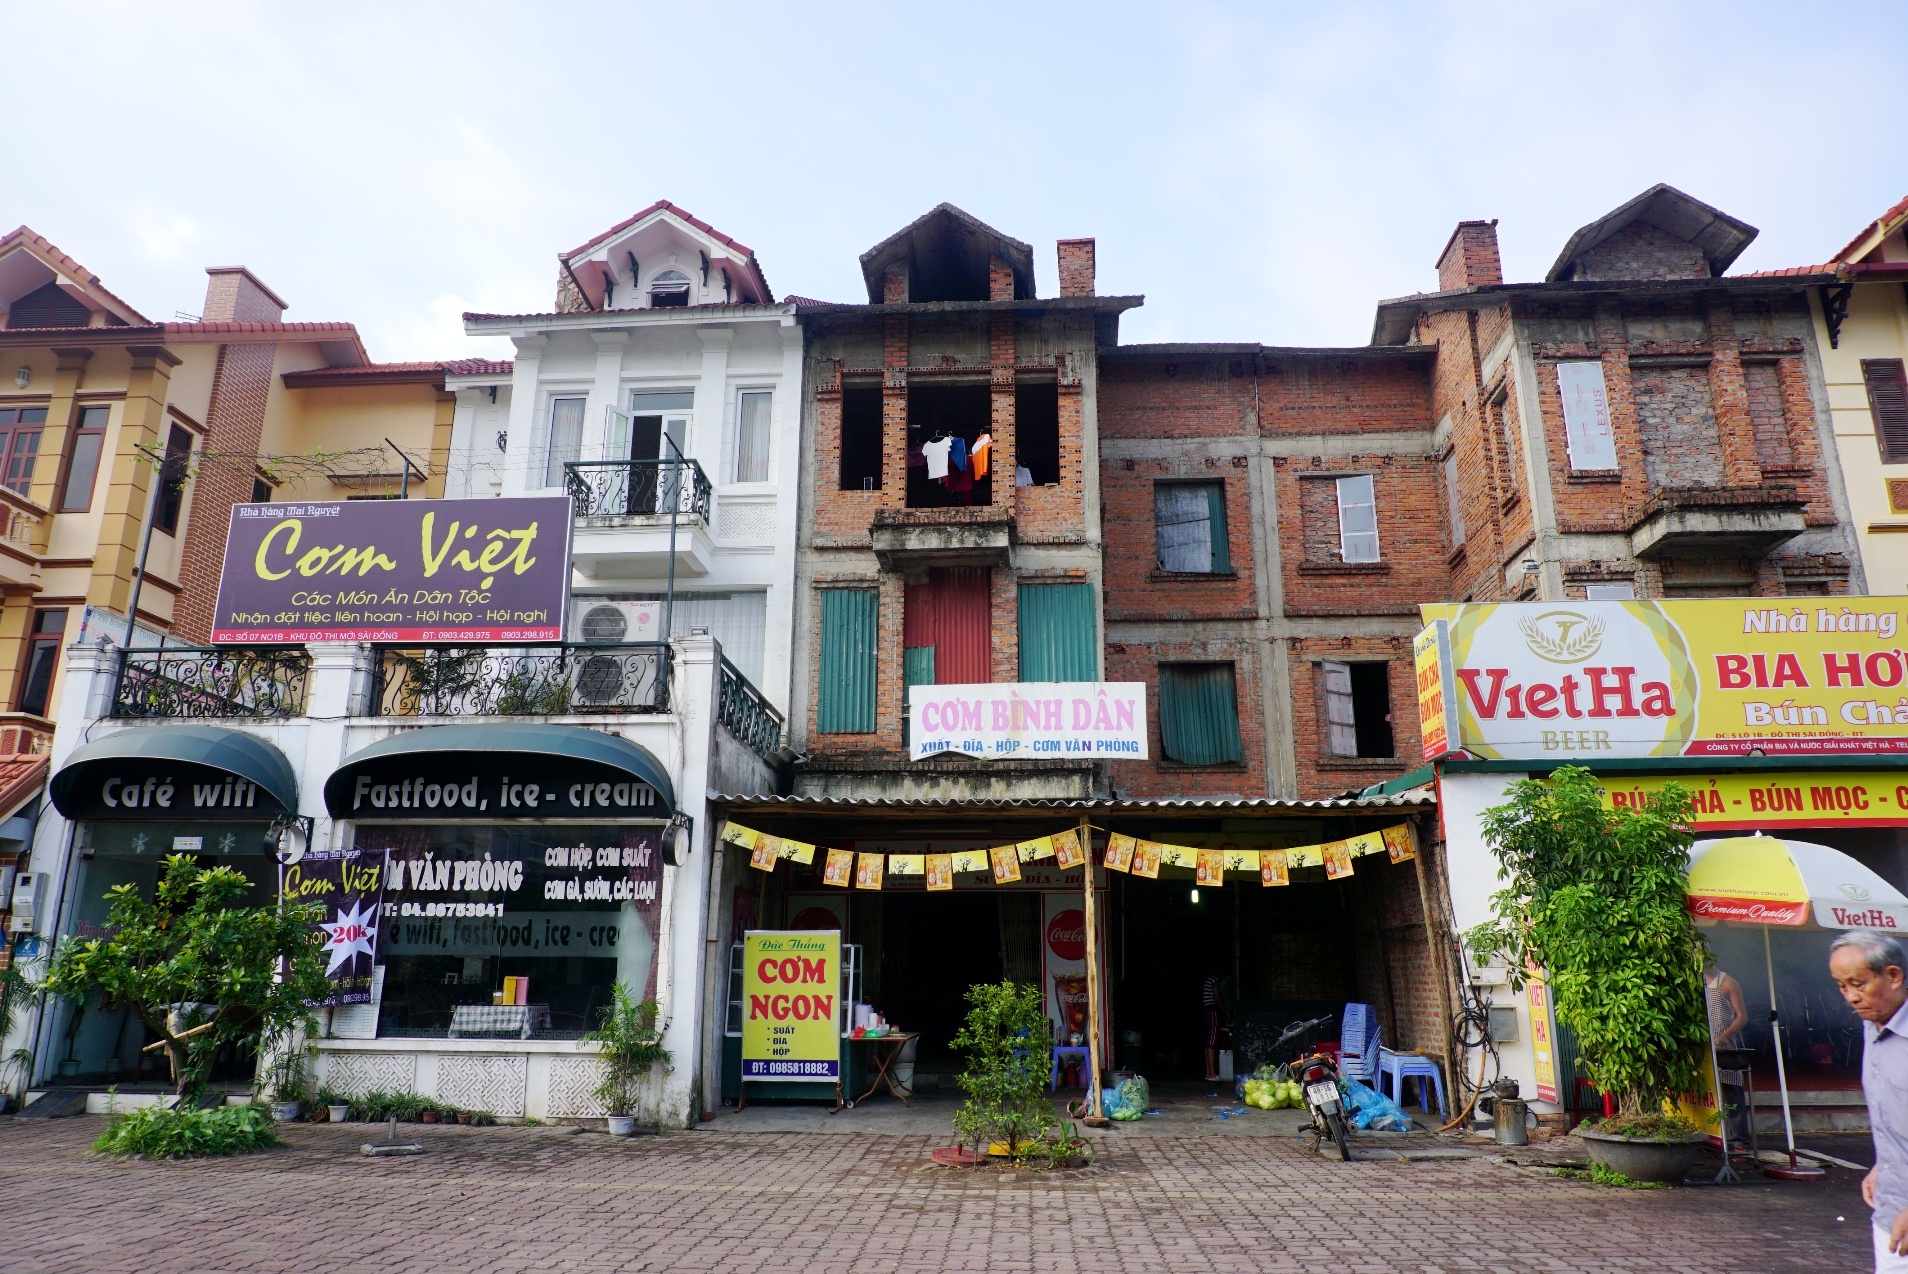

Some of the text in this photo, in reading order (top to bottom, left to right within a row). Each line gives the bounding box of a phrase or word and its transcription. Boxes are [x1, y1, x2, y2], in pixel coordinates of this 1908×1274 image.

[1593, 389, 1607, 436] LEXUS
[287, 506, 306, 516] Mai
[255, 511, 538, 590] Cơm Việt
[291, 588, 491, 606] Các Món Ăn Dân Tộc
[230, 611, 270, 625] Nhận
[274, 611, 300, 625] đặt
[303, 611, 331, 624] tiệc
[335, 611, 360, 622] liên
[364, 610, 402, 622] hoan
[415, 610, 439, 623] Hội
[443, 610, 473, 623] họp
[486, 610, 510, 623] Hội
[514, 609, 547, 623] nghị
[1743, 607, 1898, 639] Nhà hàng
[219, 633, 234, 641] ĐC:
[235, 632, 248, 641] SỐ
[309, 632, 323, 640] ĐÔ
[339, 631, 356, 640] MỚI
[357, 632, 371, 640] SÀI
[372, 631, 398, 640] ĐỒNG
[438, 631, 491, 639] 0903.429.975
[501, 631, 554, 639] 0903.298.915
[1714, 648, 1908, 690] BIA HƠ
[1456, 667, 1677, 720] VietHa
[921, 689, 1135, 733] CƠM BÌNH DÂN
[1742, 699, 1829, 726] Bún
[962, 739, 984, 752] ĐĨA
[995, 738, 1021, 754] HỘP
[1033, 739, 1061, 752] CƠM
[1065, 737, 1092, 752] VĂN
[1096, 738, 1139, 753] PHÒNG
[1541, 730, 1612, 750] BEER
[1706, 743, 1728, 751] CÔNG
[1740, 741, 1751, 750] CỔ
[1789, 741, 1799, 749] VÀ
[1800, 741, 1822, 749] NƯỚC
[1840, 741, 1860, 749] KHÁT
[1861, 741, 1878, 749] VIỆT
[1770, 730, 1784, 738] ĐÔ
[102, 776, 256, 808] Café wifi
[353, 775, 489, 811] Fastfood,
[500, 776, 540, 808] ice
[568, 781, 656, 808] cream
[1749, 783, 1804, 812] BÚN
[1810, 785, 1869, 816] MỌC
[545, 847, 569, 867] CƠM
[596, 846, 620, 867] CƠM
[621, 840, 652, 867] SUẤT
[284, 860, 380, 899] Cơm Việt
[409, 851, 451, 891] VĂN
[452, 851, 524, 892] PHÒNG
[1064, 872, 1085, 887] HỘ
[544, 880, 566, 900] CƠM
[613, 876, 634, 900] CÁC
[634, 880, 656, 905] LOẠI
[1698, 887, 1789, 897] www.viethacorp.com.vn
[1694, 900, 1796, 923] Premium Quality
[1831, 907, 1897, 928] VietHa
[544, 919, 571, 947] ice
[758, 938, 826, 951] Đức Thắng
[757, 955, 827, 984] CƠM
[749, 994, 833, 1021] NGON
[773, 1024, 795, 1035] SUẤT
[772, 1047, 790, 1057] HỘP
[751, 1062, 829, 1074] ĐT: 0985818882
